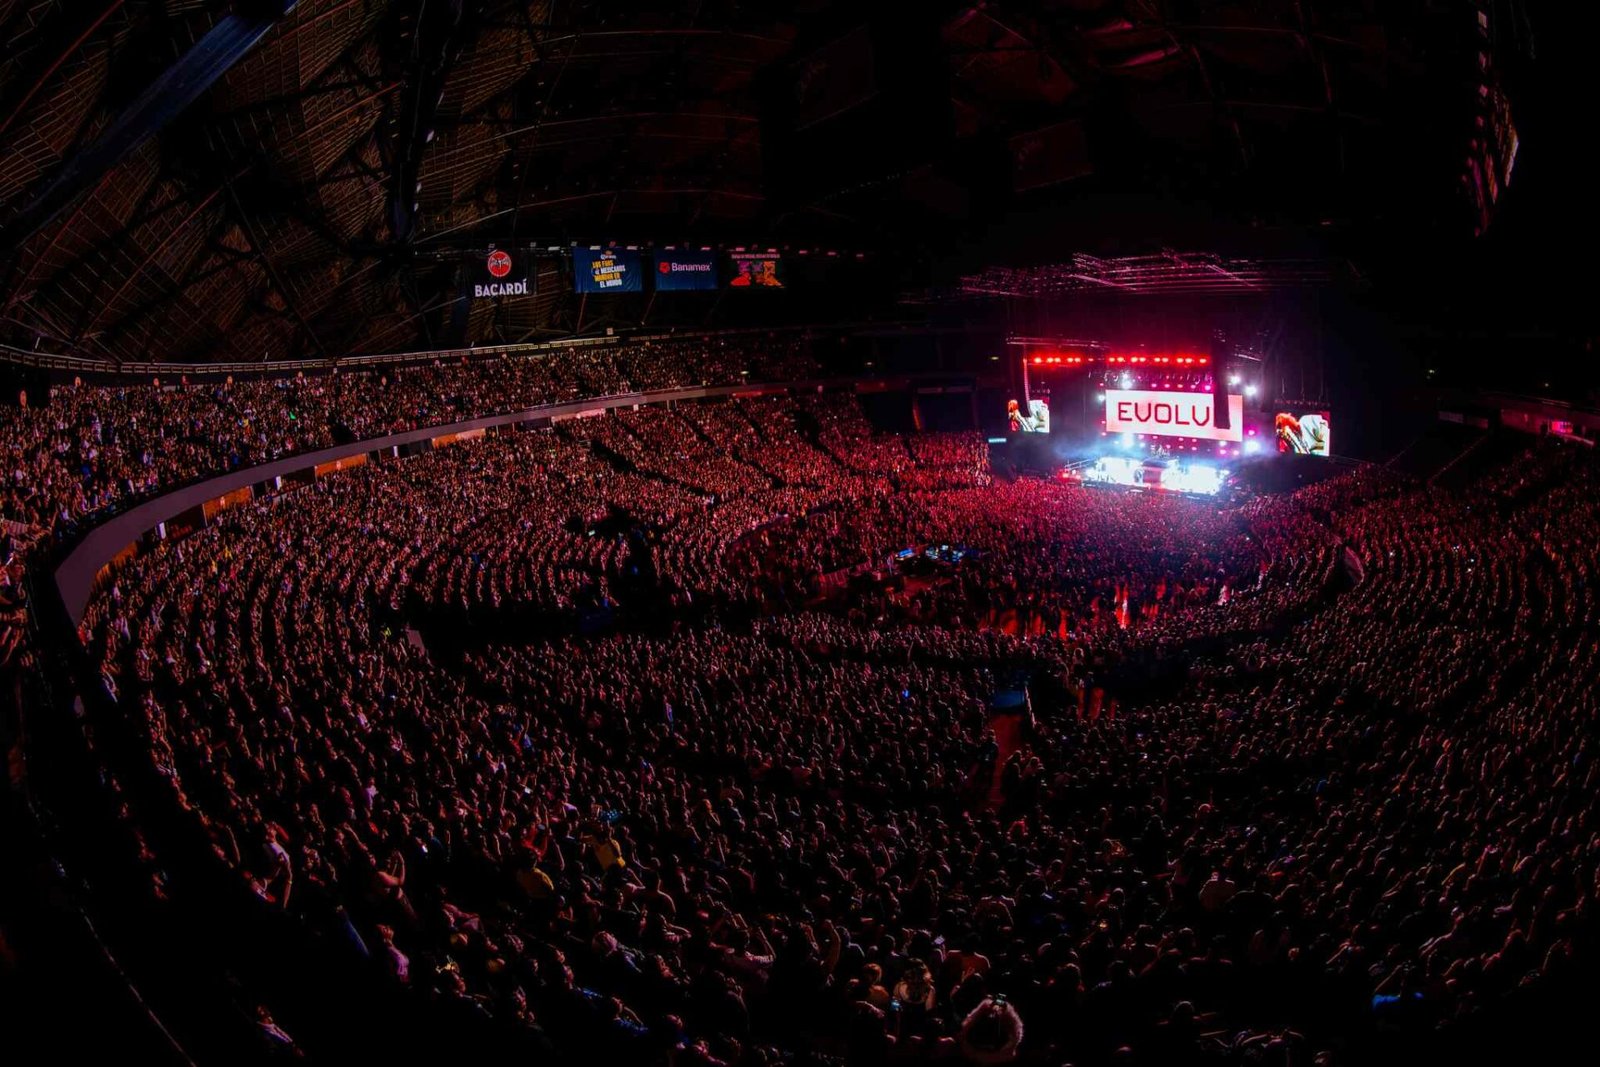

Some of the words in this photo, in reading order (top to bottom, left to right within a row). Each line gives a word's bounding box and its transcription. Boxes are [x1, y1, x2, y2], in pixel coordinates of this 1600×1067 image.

[671, 262, 711, 272] Banamex
[474, 278, 528, 297] BACARDÍ
[1118, 402, 1210, 427] EVOLV
